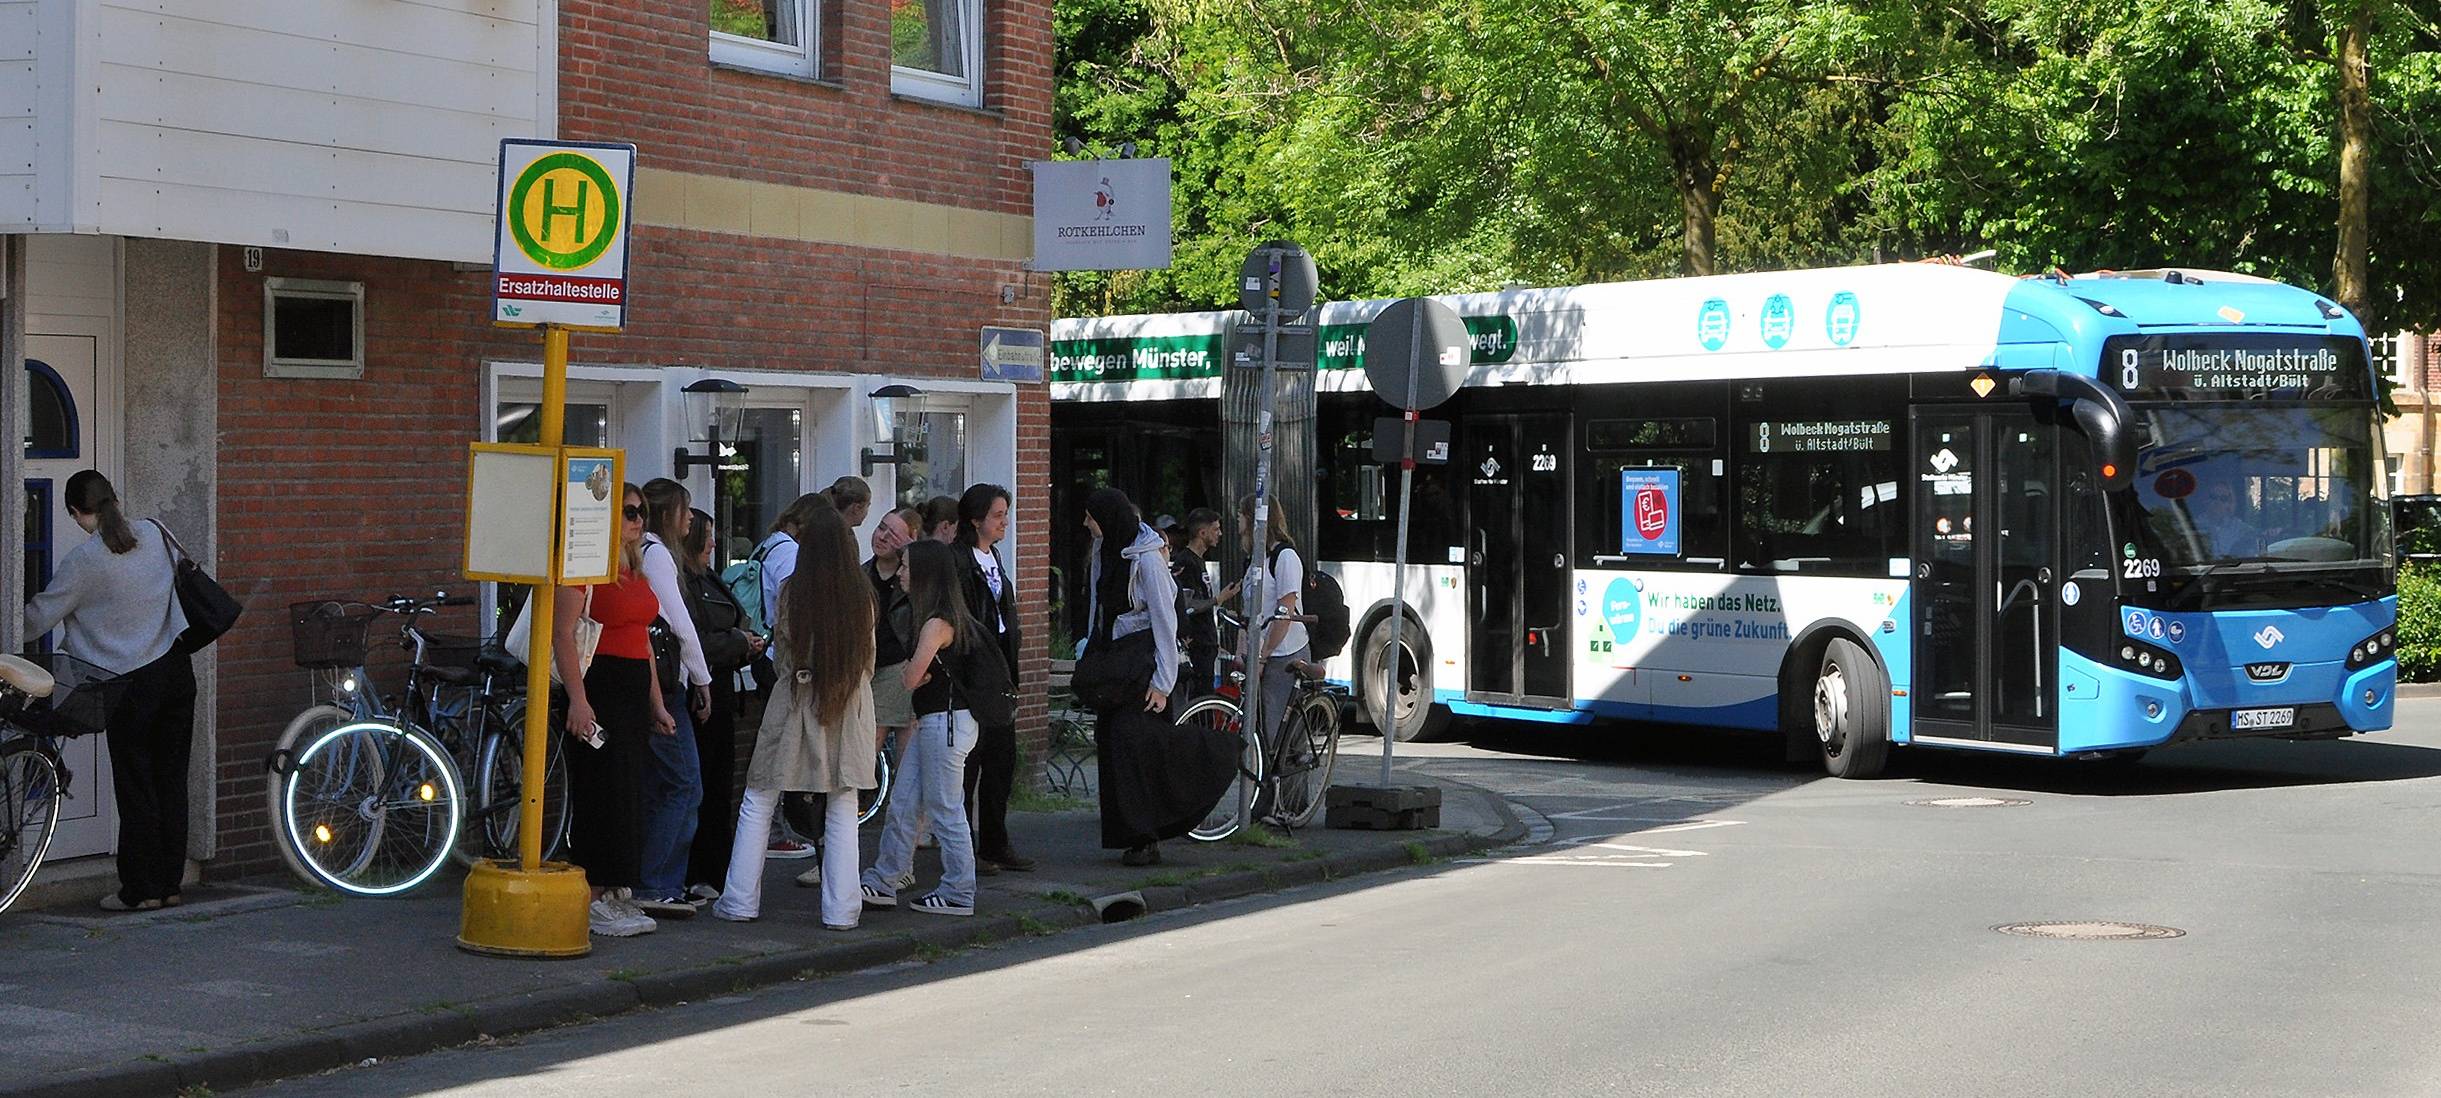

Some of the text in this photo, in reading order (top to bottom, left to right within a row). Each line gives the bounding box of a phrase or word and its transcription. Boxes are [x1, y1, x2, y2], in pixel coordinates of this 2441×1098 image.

[541, 179, 587, 243] H
[1058, 225, 1146, 238] ROTKEHLCHEN
[247, 249, 260, 268] 19
[499, 278, 620, 299] Ersatzhaltestelle
[1325, 335, 1355, 357] weil
[1050, 348, 1211, 374] bewegen Münster,
[2121, 348, 2337, 389] 8 Wolbeck Nogatstraße
[2194, 373, 2309, 388] ü. Altstadt/Bült
[1759, 421, 1889, 452] 8 Wolbeck Nogatstraße
[1795, 437, 1874, 451] ü. Altstadt/Bült
[1532, 454, 1556, 471] 2269
[2124, 559, 2160, 578] 2269
[1648, 592, 1669, 608] Wir
[1674, 593, 1714, 610] haben
[1718, 593, 1742, 612] das
[1745, 594, 1781, 613] Netz.
[1648, 618, 1664, 634] Du
[1668, 618, 1689, 636] die
[1691, 618, 1731, 640] grüne
[1735, 620, 1793, 641] Zukunft.
[2251, 665, 2283, 676] VDL
[2236, 710, 2292, 727] MS ST 2269
